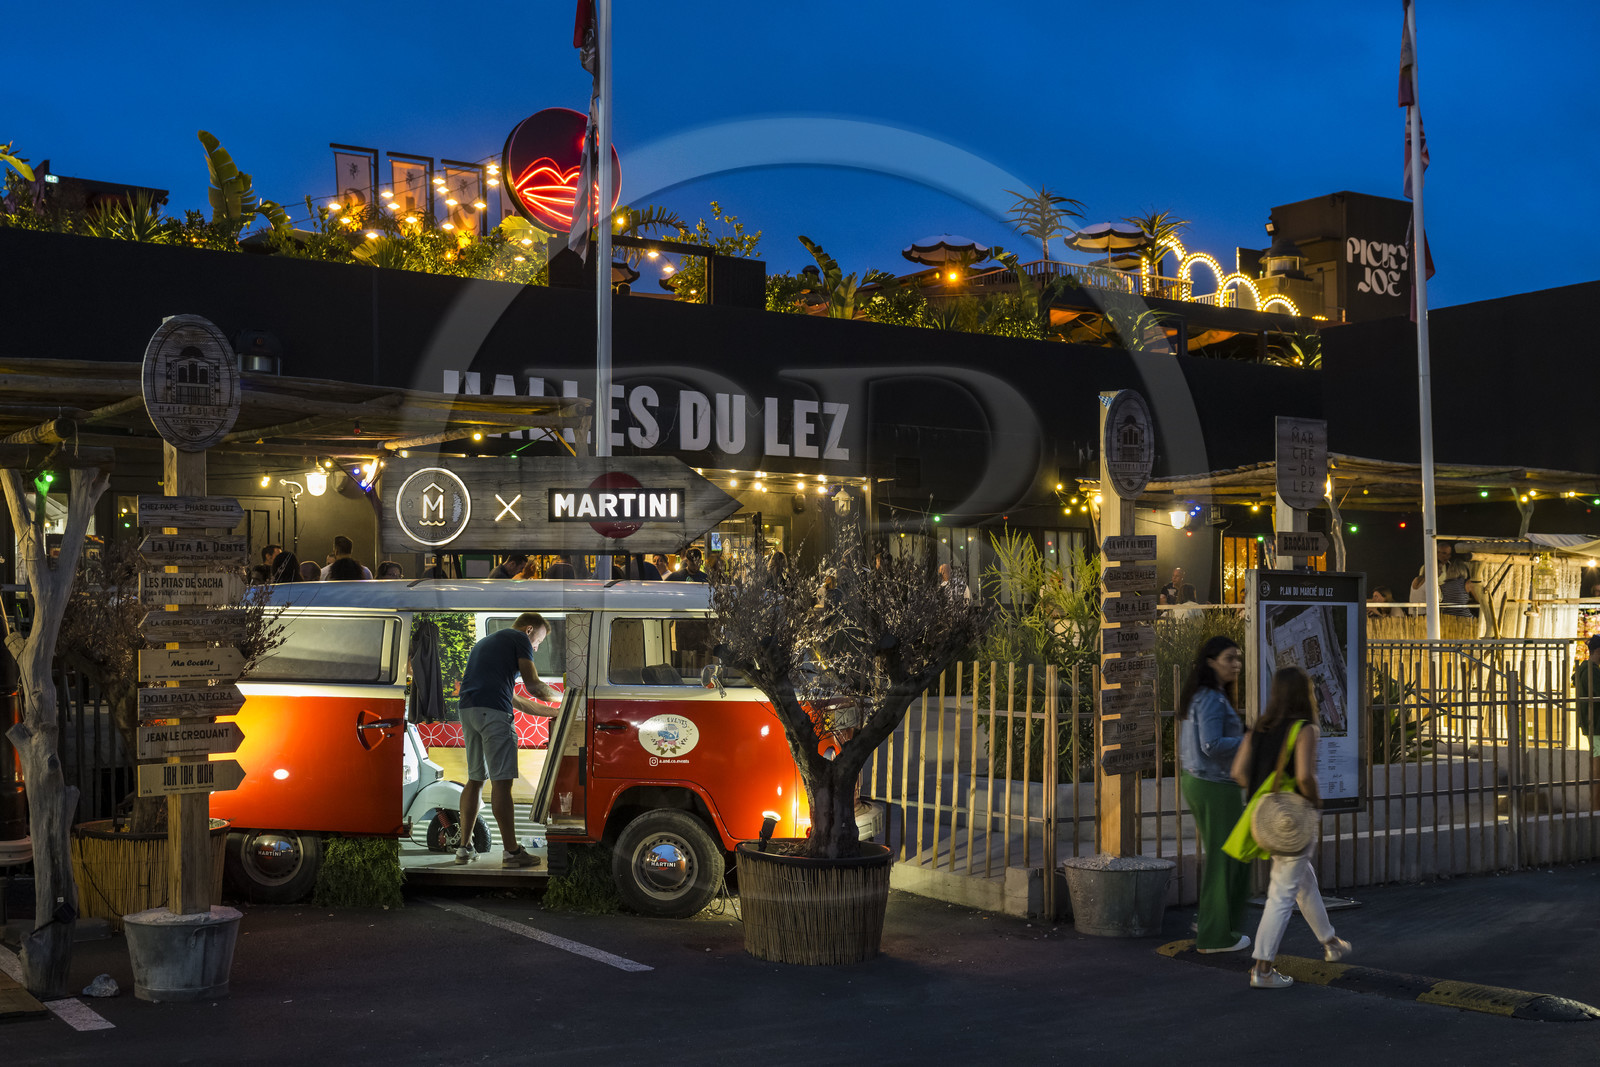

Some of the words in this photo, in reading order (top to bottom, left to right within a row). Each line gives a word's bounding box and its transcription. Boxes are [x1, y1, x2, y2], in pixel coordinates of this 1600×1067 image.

[1346, 236, 1409, 271] PICKY
[1357, 267, 1402, 297] JOE
[680, 389, 746, 455] DU
[764, 397, 849, 460] LEZ
[1293, 480, 1314, 493] LEZ
[554, 493, 679, 518] MARTINI
[144, 578, 160, 588] LES
[162, 578, 184, 588] PITAS
[186, 578, 196, 588] DE
[198, 578, 223, 588] SACHA
[1280, 586, 1292, 596] PLAN
[1292, 586, 1299, 596] DU
[1318, 587, 1324, 596] DU
[1325, 587, 1334, 597] LEZ
[1110, 662, 1127, 672] CHEZ
[144, 694, 168, 704] DOM
[170, 693, 195, 702] PATA
[198, 692, 233, 701] NEGRA
[145, 733, 168, 742] JEAN
[170, 732, 180, 740] LE
[182, 728, 230, 740] CROQUANT
